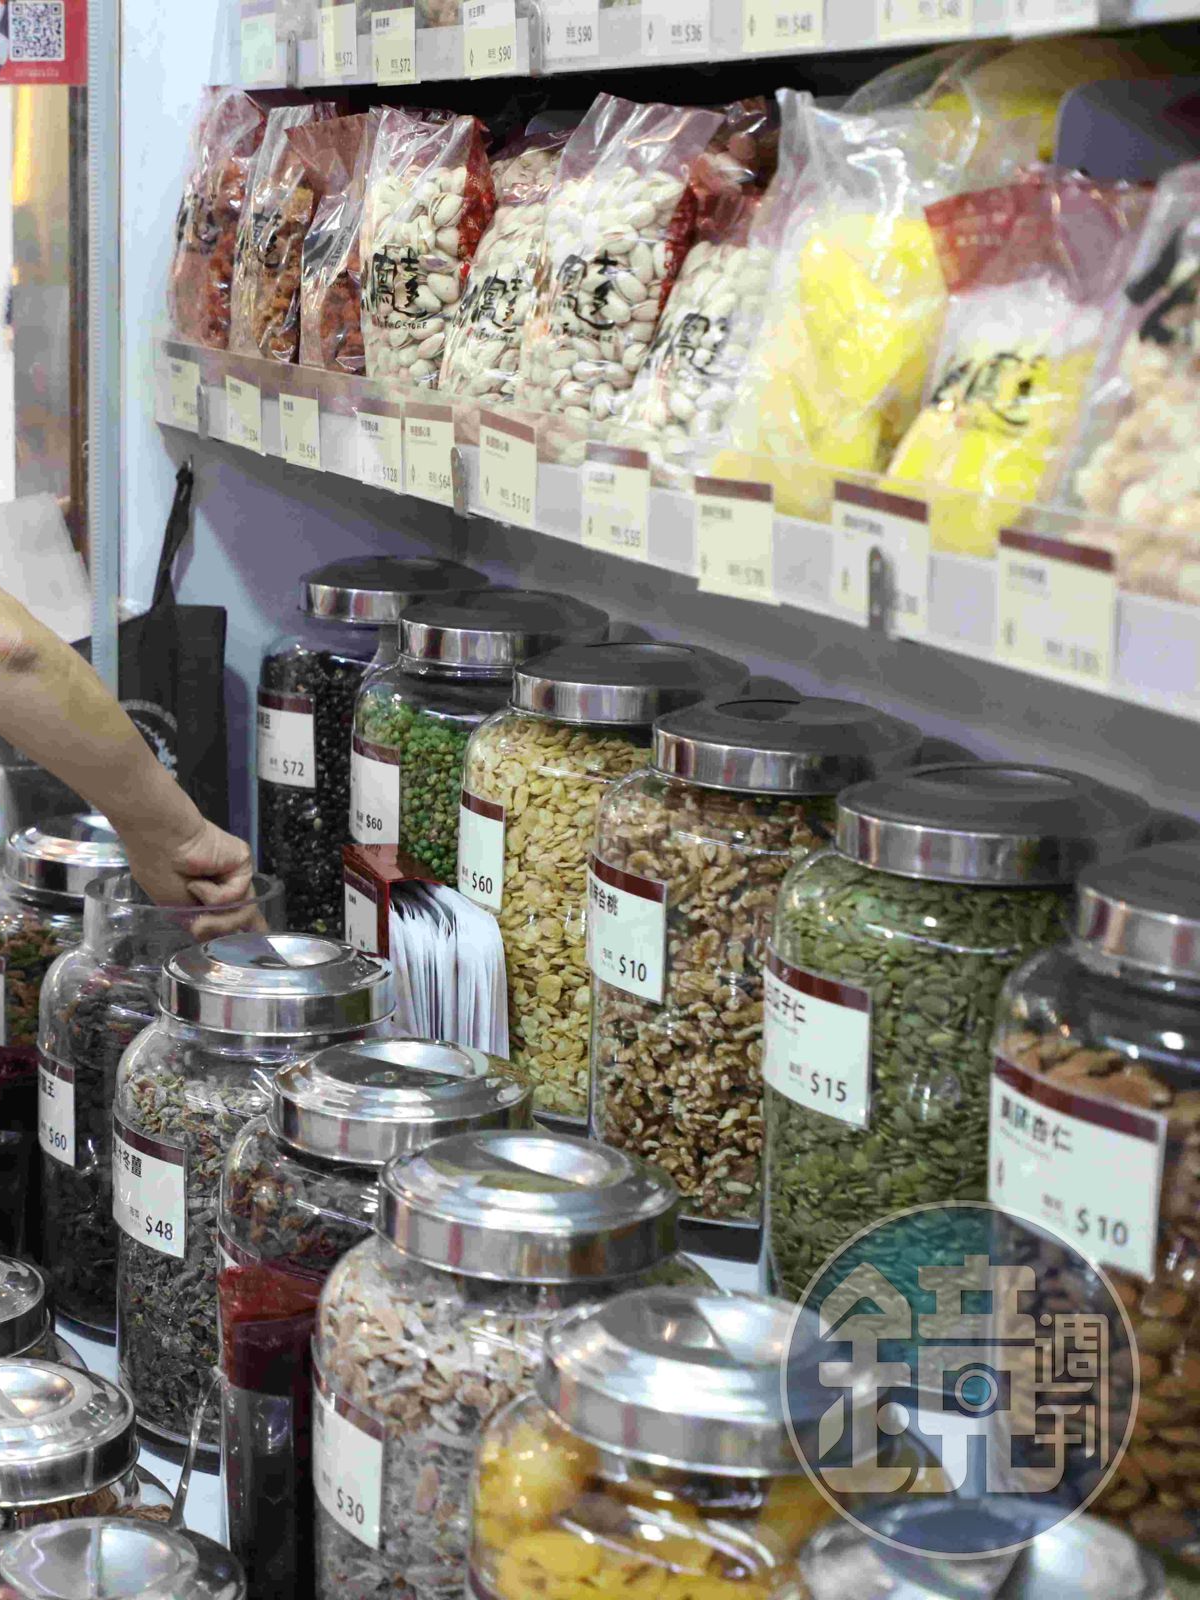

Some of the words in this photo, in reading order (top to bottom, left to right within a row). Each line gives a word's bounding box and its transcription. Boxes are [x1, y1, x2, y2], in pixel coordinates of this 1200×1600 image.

[282, 758, 305, 777] $72
[365, 813, 383, 832] $60
[471, 870, 493, 895] $60
[619, 952, 647, 983] $10
[810, 1071, 849, 1103] $15
[49, 1127, 67, 1151] $60
[145, 1214, 174, 1241] $48
[1075, 1206, 1130, 1247] $10
[336, 1487, 365, 1525] $30
